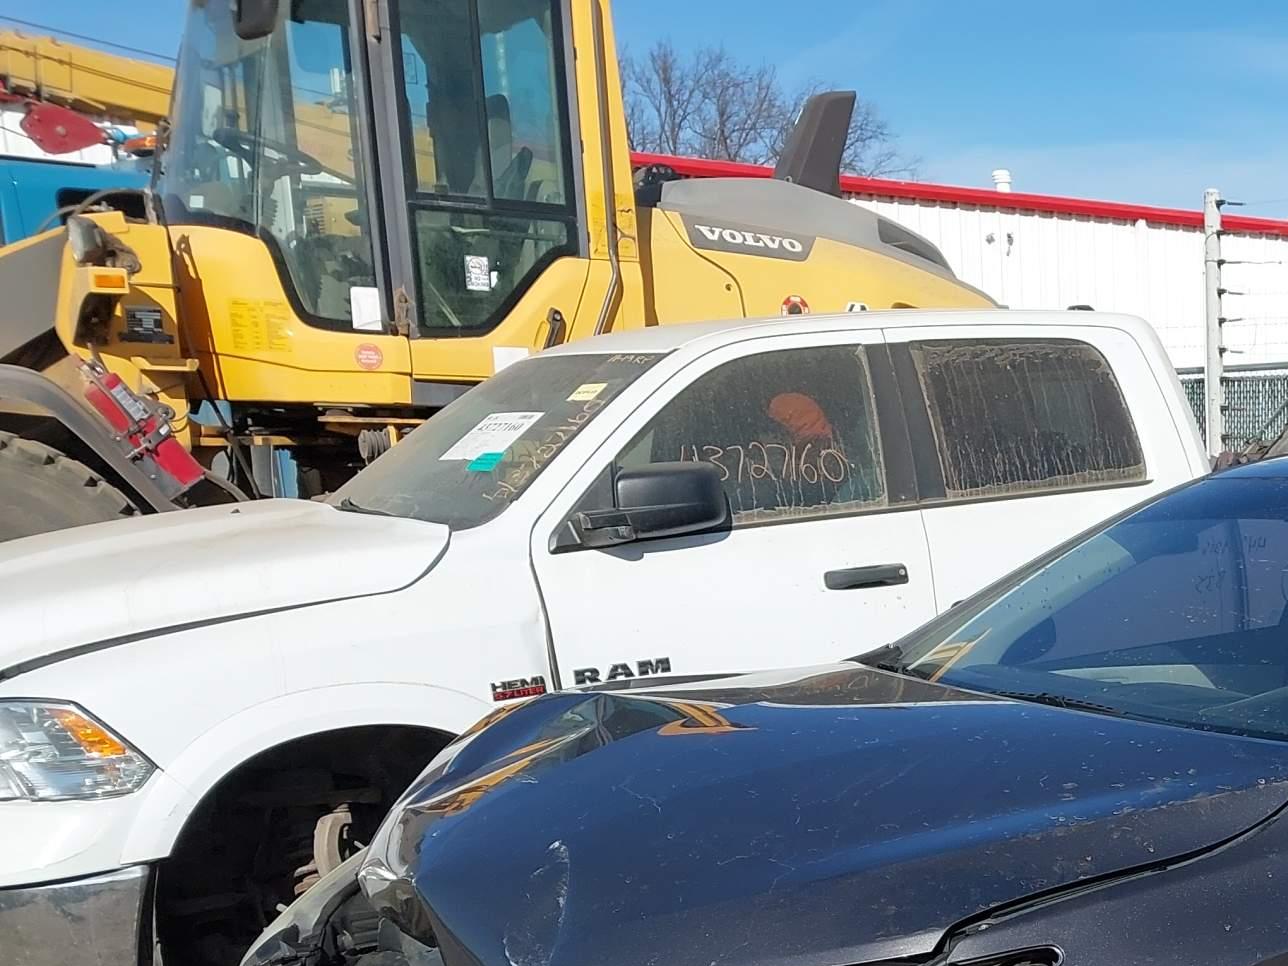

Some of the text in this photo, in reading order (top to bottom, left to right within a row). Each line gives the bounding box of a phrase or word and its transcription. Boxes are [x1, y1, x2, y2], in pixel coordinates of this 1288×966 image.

[694, 224, 803, 252] VOLVO
[573, 656, 672, 686] RAM
[491, 675, 545, 692] HEMI
[513, 685, 545, 698] LITER
